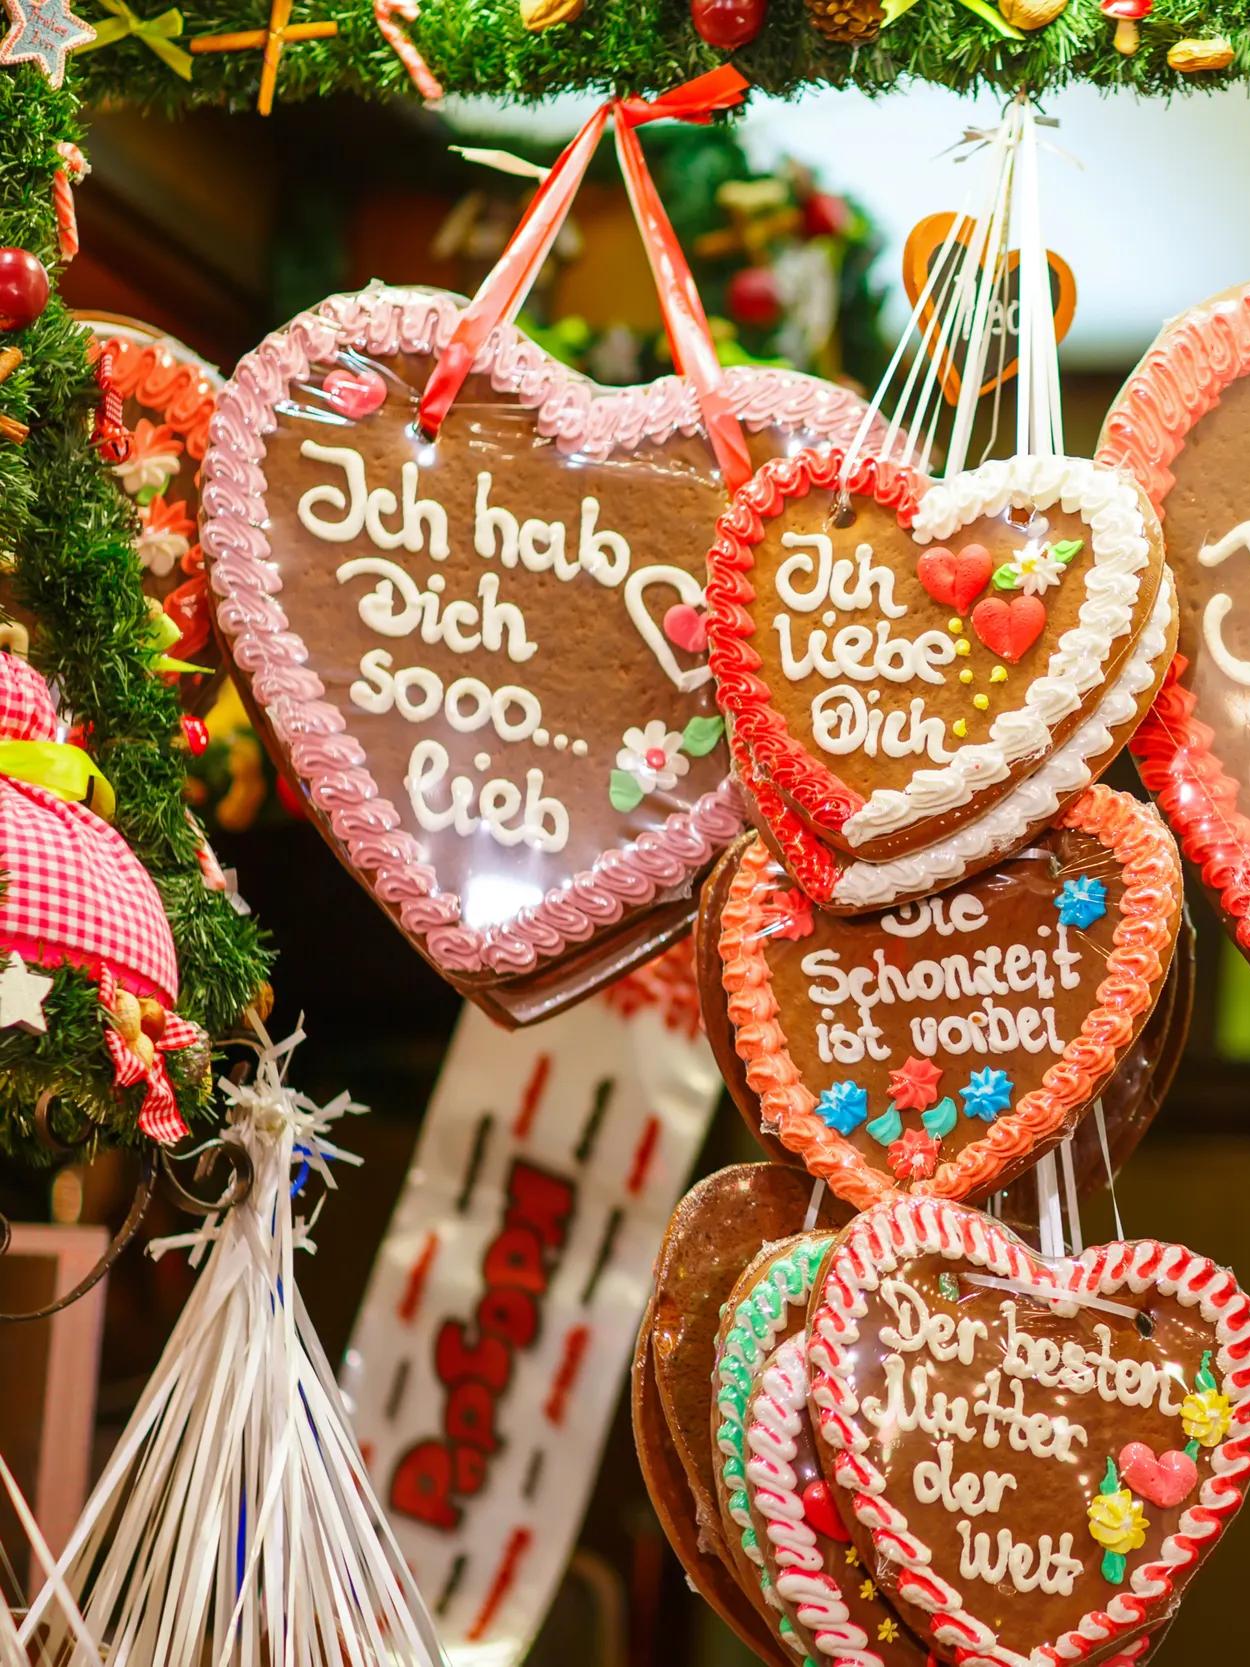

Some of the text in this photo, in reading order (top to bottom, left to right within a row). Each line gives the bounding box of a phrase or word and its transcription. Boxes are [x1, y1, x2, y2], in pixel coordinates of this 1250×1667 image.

[297, 439, 631, 588] Ich hab
[336, 557, 538, 662] Dich
[775, 531, 907, 619] Ich
[773, 611, 956, 685] liebe
[350, 648, 588, 756] sooo...
[811, 684, 957, 764] Dich
[404, 739, 570, 853] lieb
[800, 922, 1082, 1007] Schonzeit
[815, 1005, 891, 1064] ist
[910, 997, 1065, 1056] vorbei
[878, 1279, 1183, 1417] Der besten
[861, 1353, 1088, 1463] Mutter
[913, 1440, 1018, 1516] der
[956, 1520, 1084, 1597] Welt
